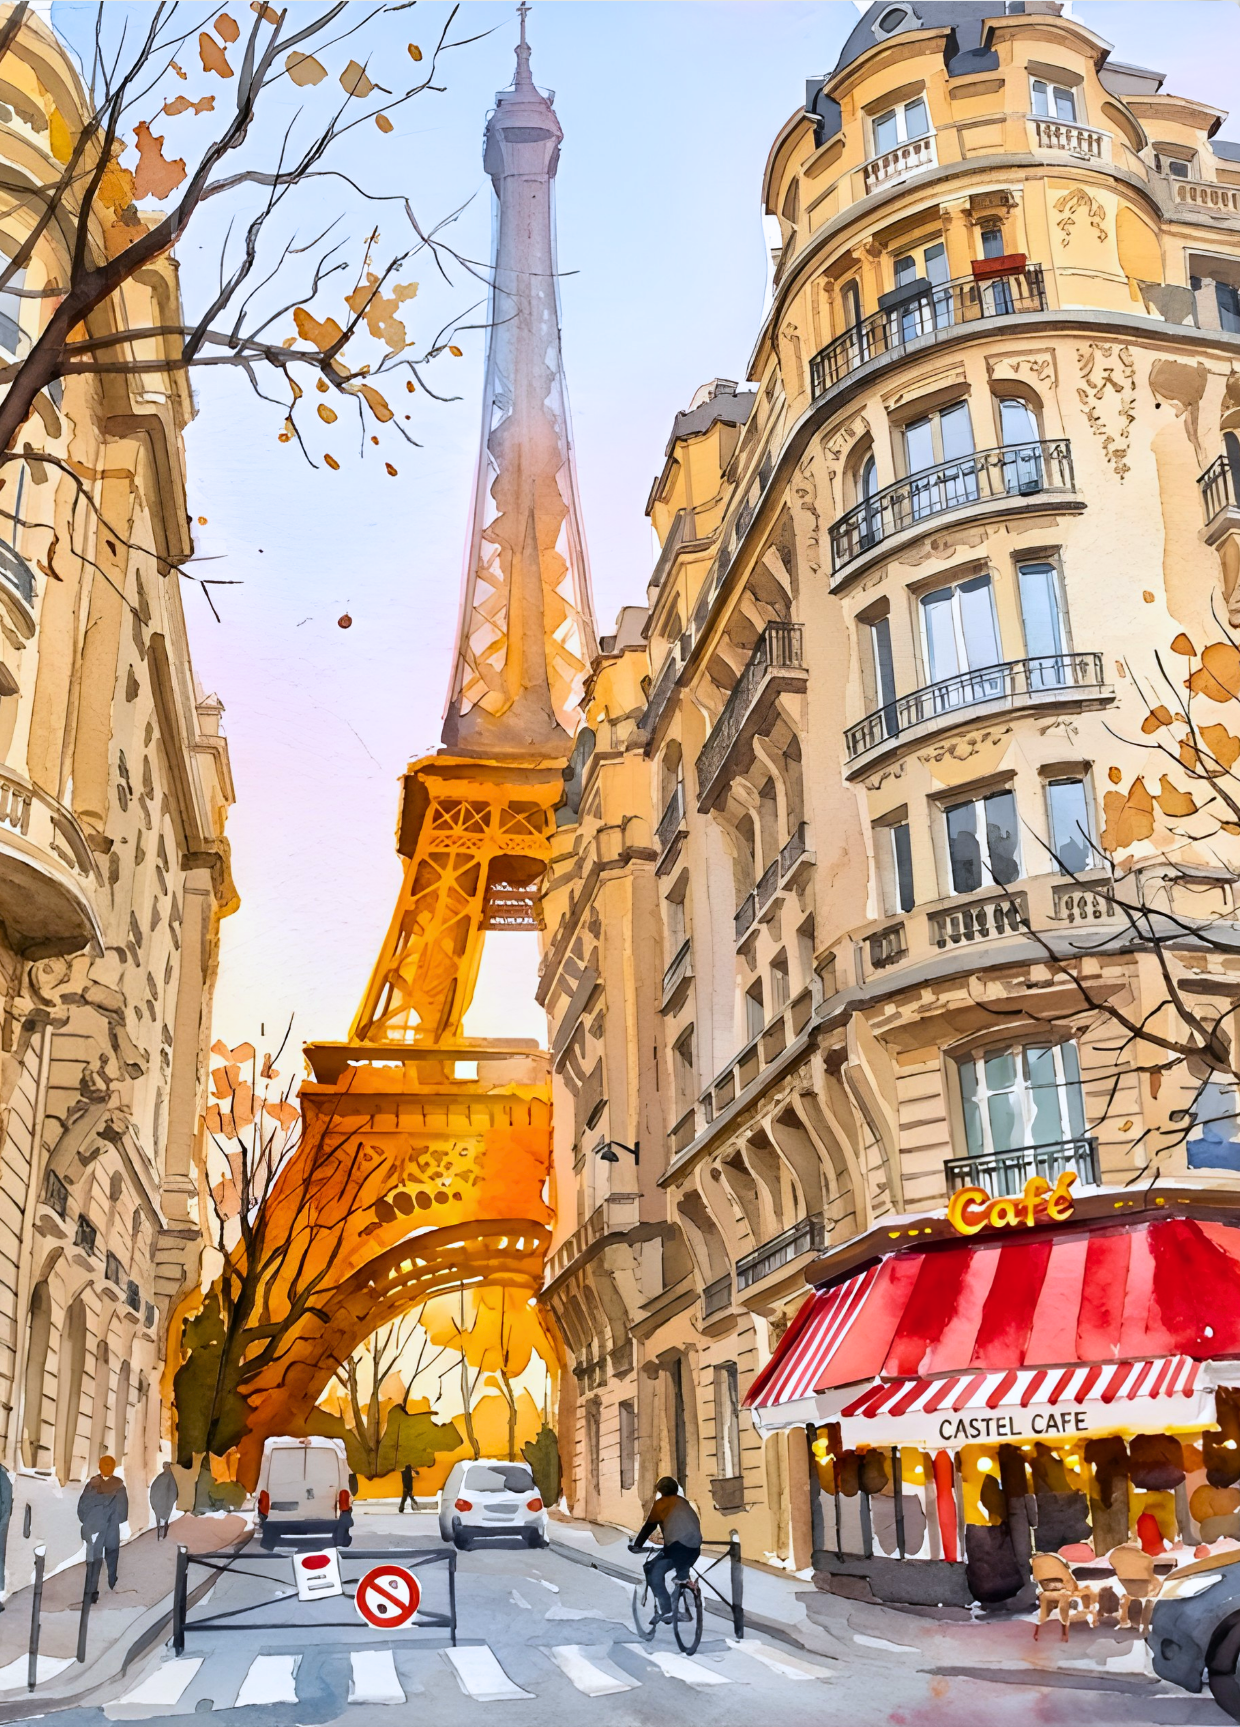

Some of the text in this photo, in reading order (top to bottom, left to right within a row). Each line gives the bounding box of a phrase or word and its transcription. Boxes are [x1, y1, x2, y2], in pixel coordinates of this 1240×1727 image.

[948, 1171, 1077, 1235] Café
[939, 1411, 1089, 1440] CASTEL CAFE
